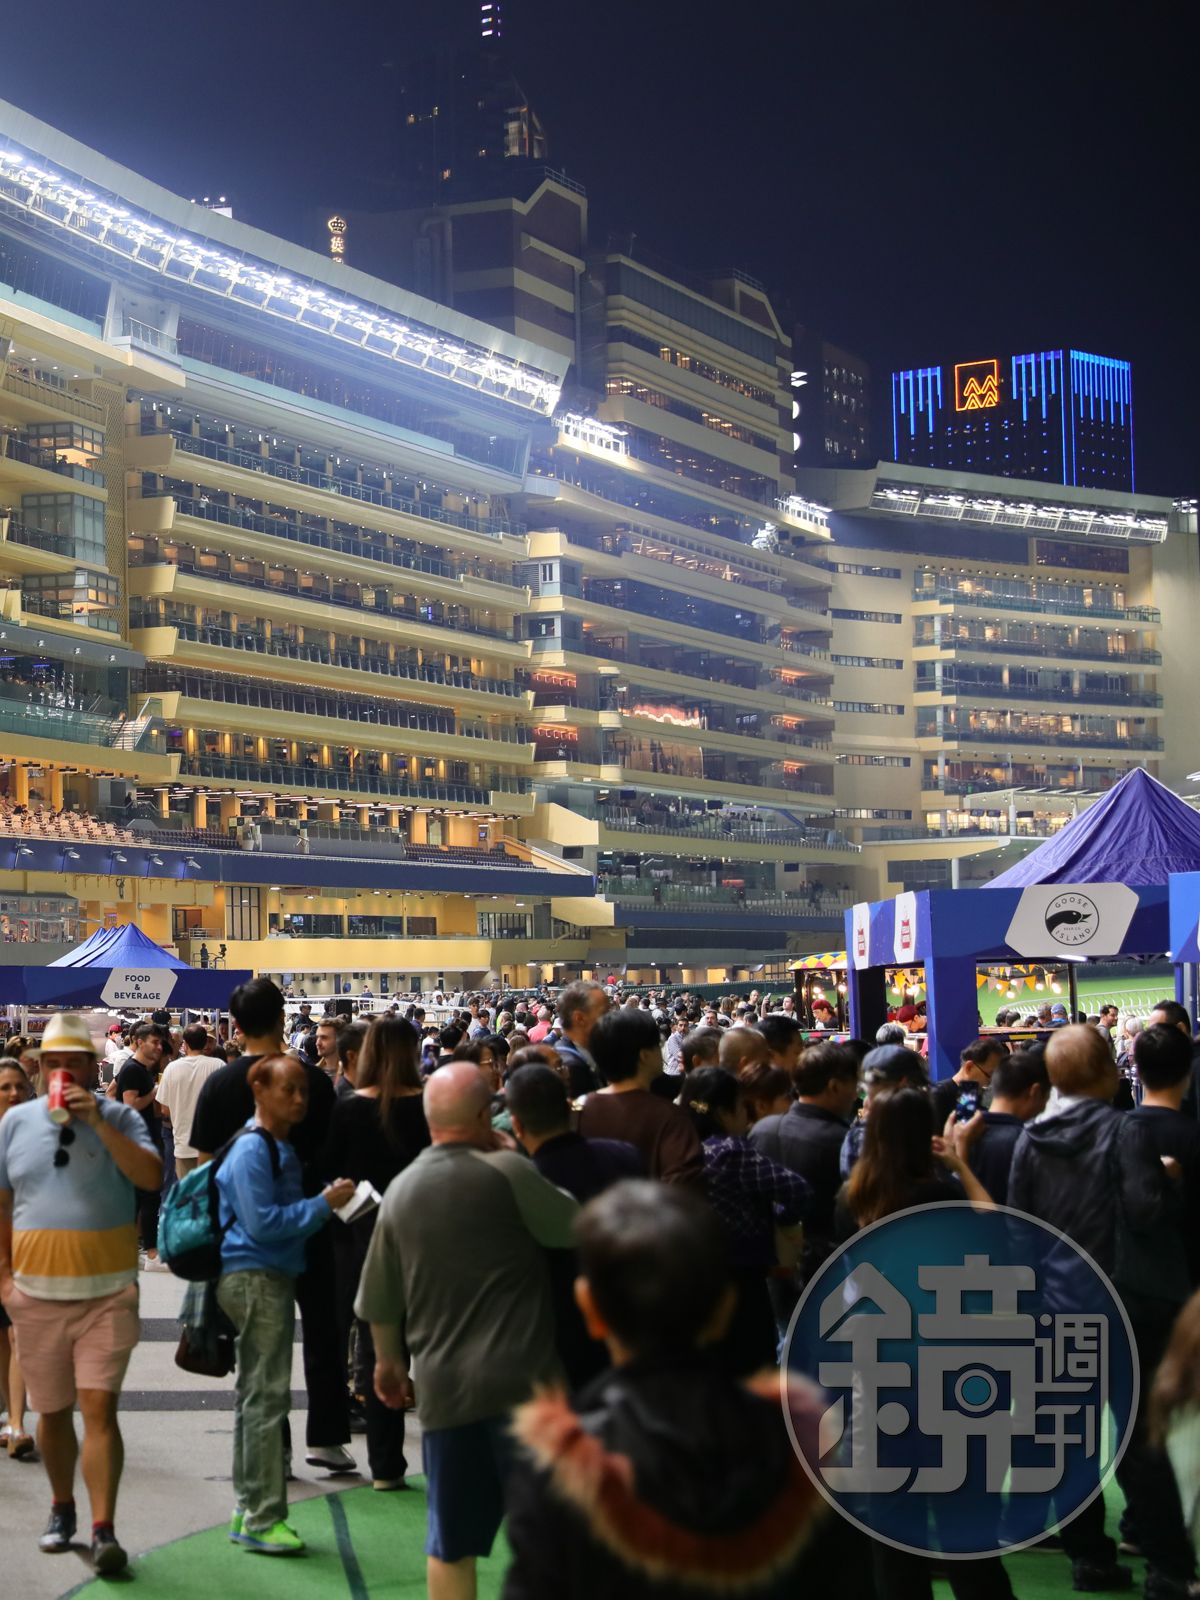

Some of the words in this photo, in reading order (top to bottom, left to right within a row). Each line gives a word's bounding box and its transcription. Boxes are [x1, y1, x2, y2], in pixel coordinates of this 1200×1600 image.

[1055, 896, 1088, 908] GOOSE
[1055, 928, 1091, 941] ISLAND
[124, 974, 151, 983] FOOD
[134, 983, 140, 991] &
[114, 991, 161, 1000] BEVERAGE
